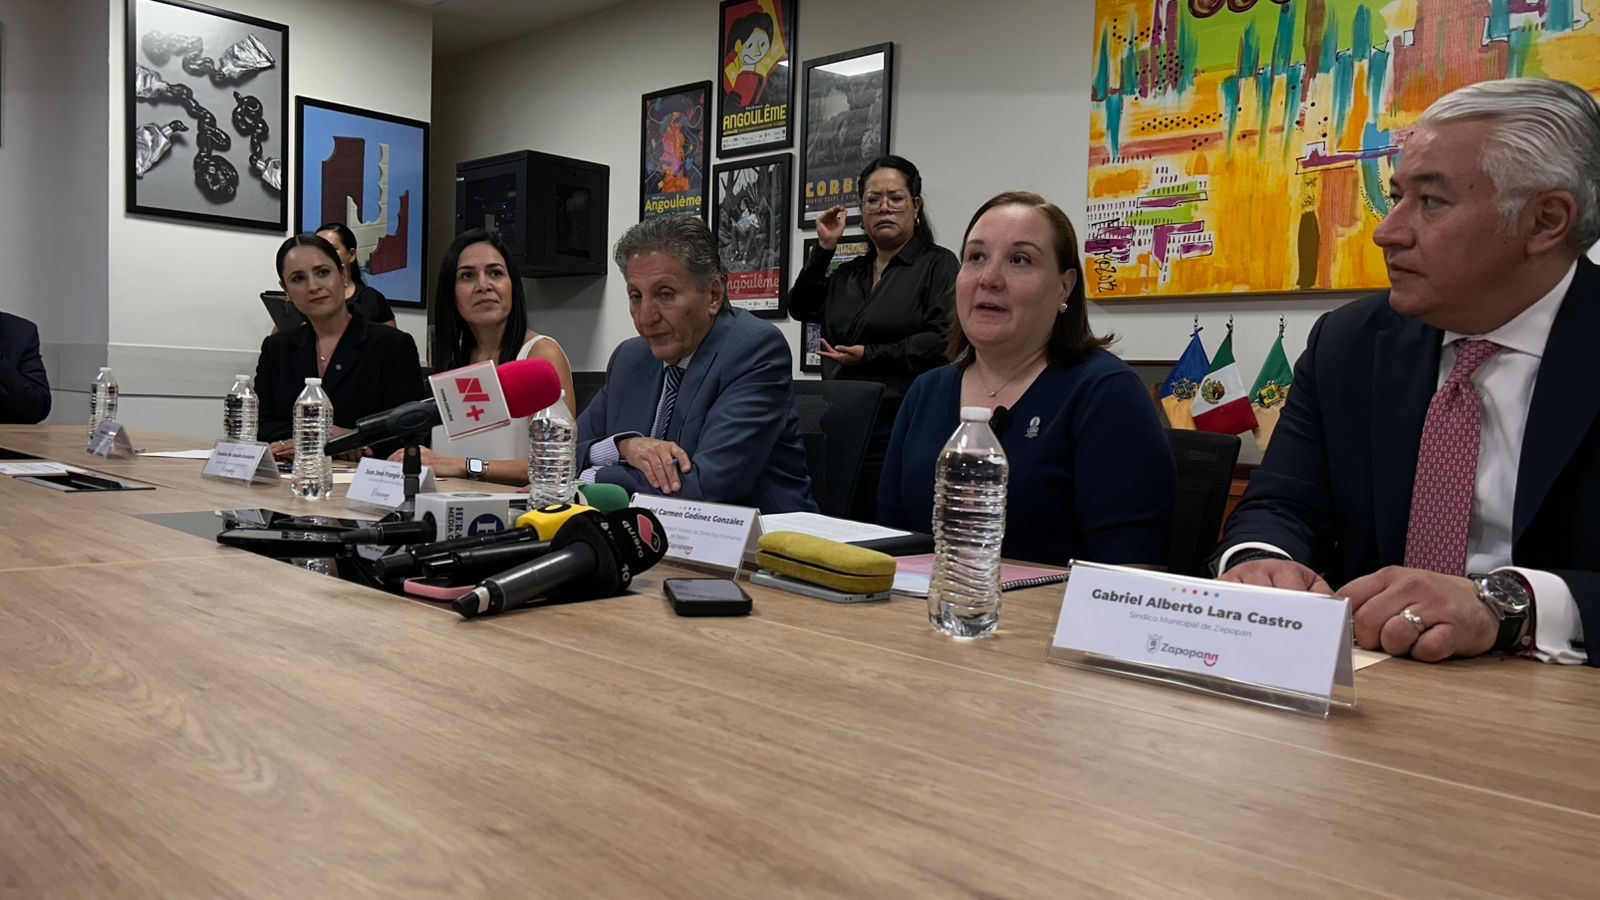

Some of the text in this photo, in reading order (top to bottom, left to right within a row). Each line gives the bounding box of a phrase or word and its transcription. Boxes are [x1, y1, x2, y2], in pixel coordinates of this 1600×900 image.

[723, 103, 787, 130] ANGOULÊME
[645, 194, 702, 213] Angoulême
[727, 272, 780, 295] ngoulême
[658, 508, 683, 518] Carmen
[684, 511, 711, 522] Godínez
[712, 514, 744, 526] González
[621, 520, 644, 558] quiero
[1092, 588, 1303, 630] Gabriel Alberto Lara Castro
[1159, 616, 1200, 630] Municipal
[1201, 621, 1212, 630] de
[1213, 623, 1252, 638] Zapopan
